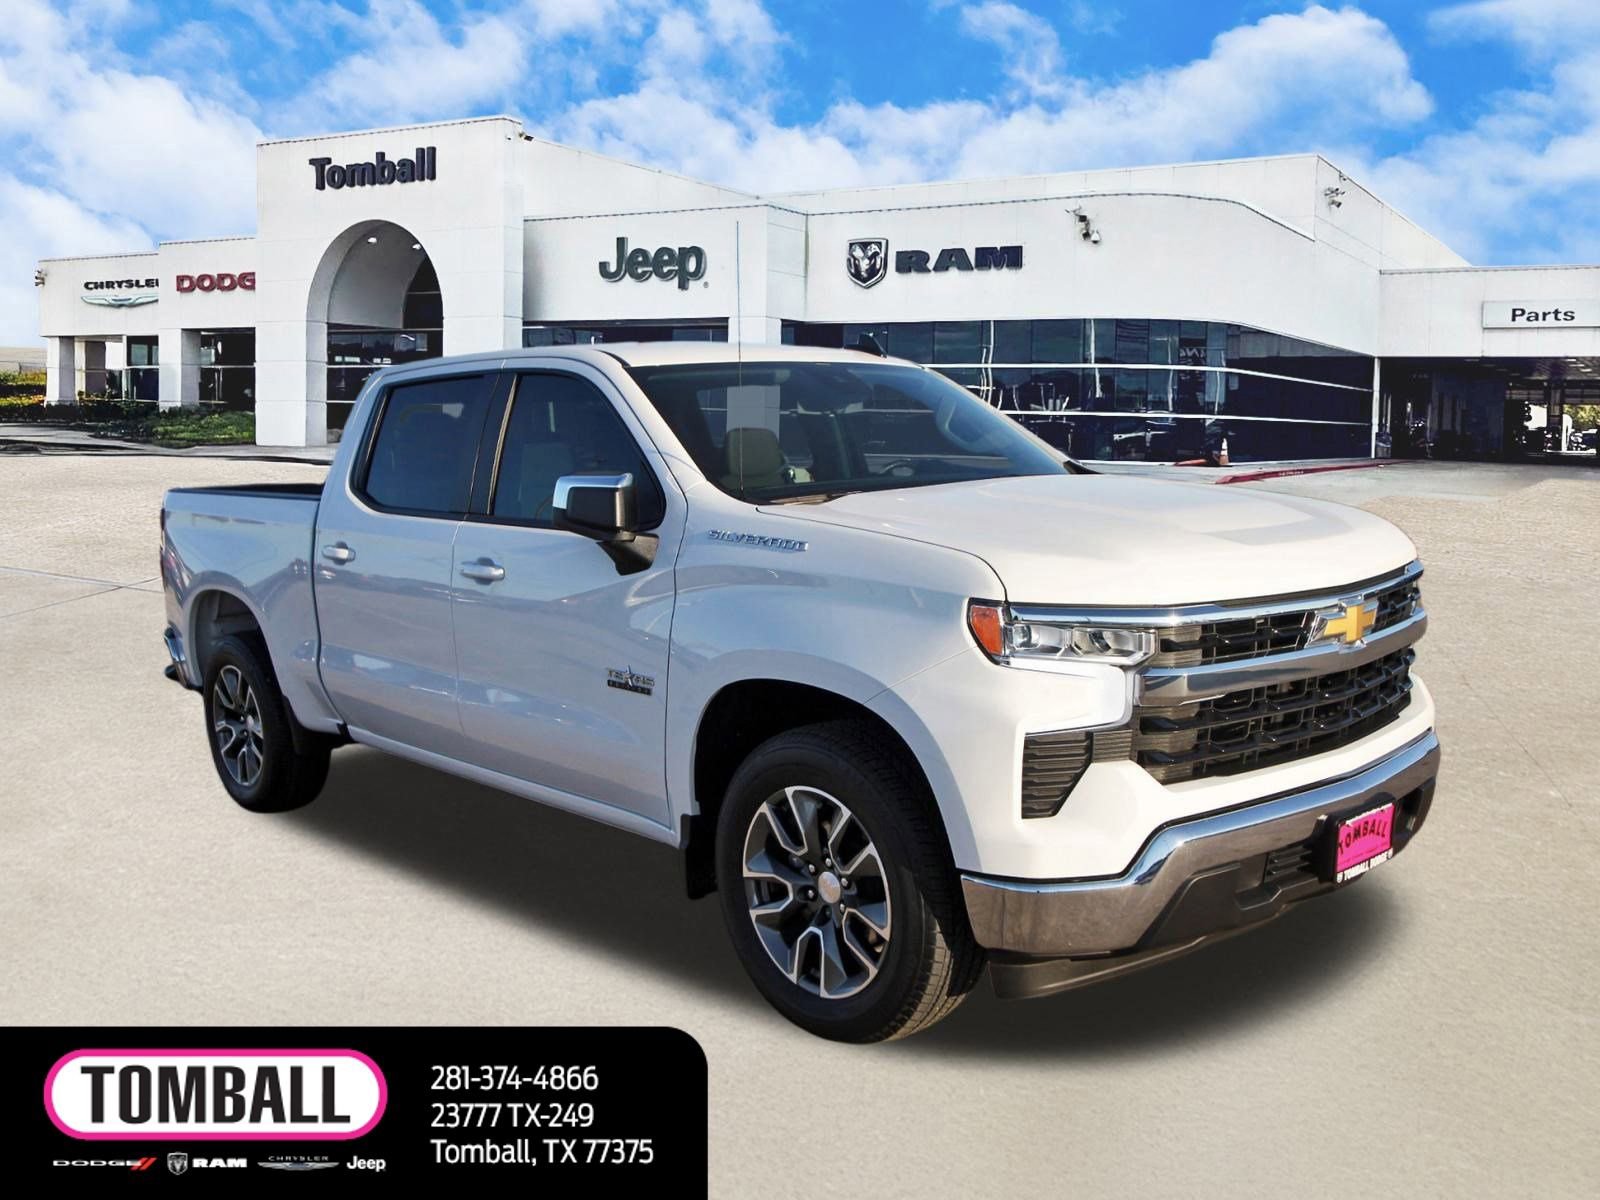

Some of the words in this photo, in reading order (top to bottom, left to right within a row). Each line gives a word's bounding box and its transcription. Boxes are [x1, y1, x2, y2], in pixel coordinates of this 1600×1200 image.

[309, 146, 436, 190] Tomball
[599, 237, 707, 290] Jeep
[895, 245, 1023, 274] RAM
[83, 278, 159, 291] CHRYSLE
[176, 271, 256, 293] DODG
[1511, 307, 1575, 322] Parts
[708, 528, 808, 552] SILVERADO
[1338, 819, 1388, 854] TOMBALL
